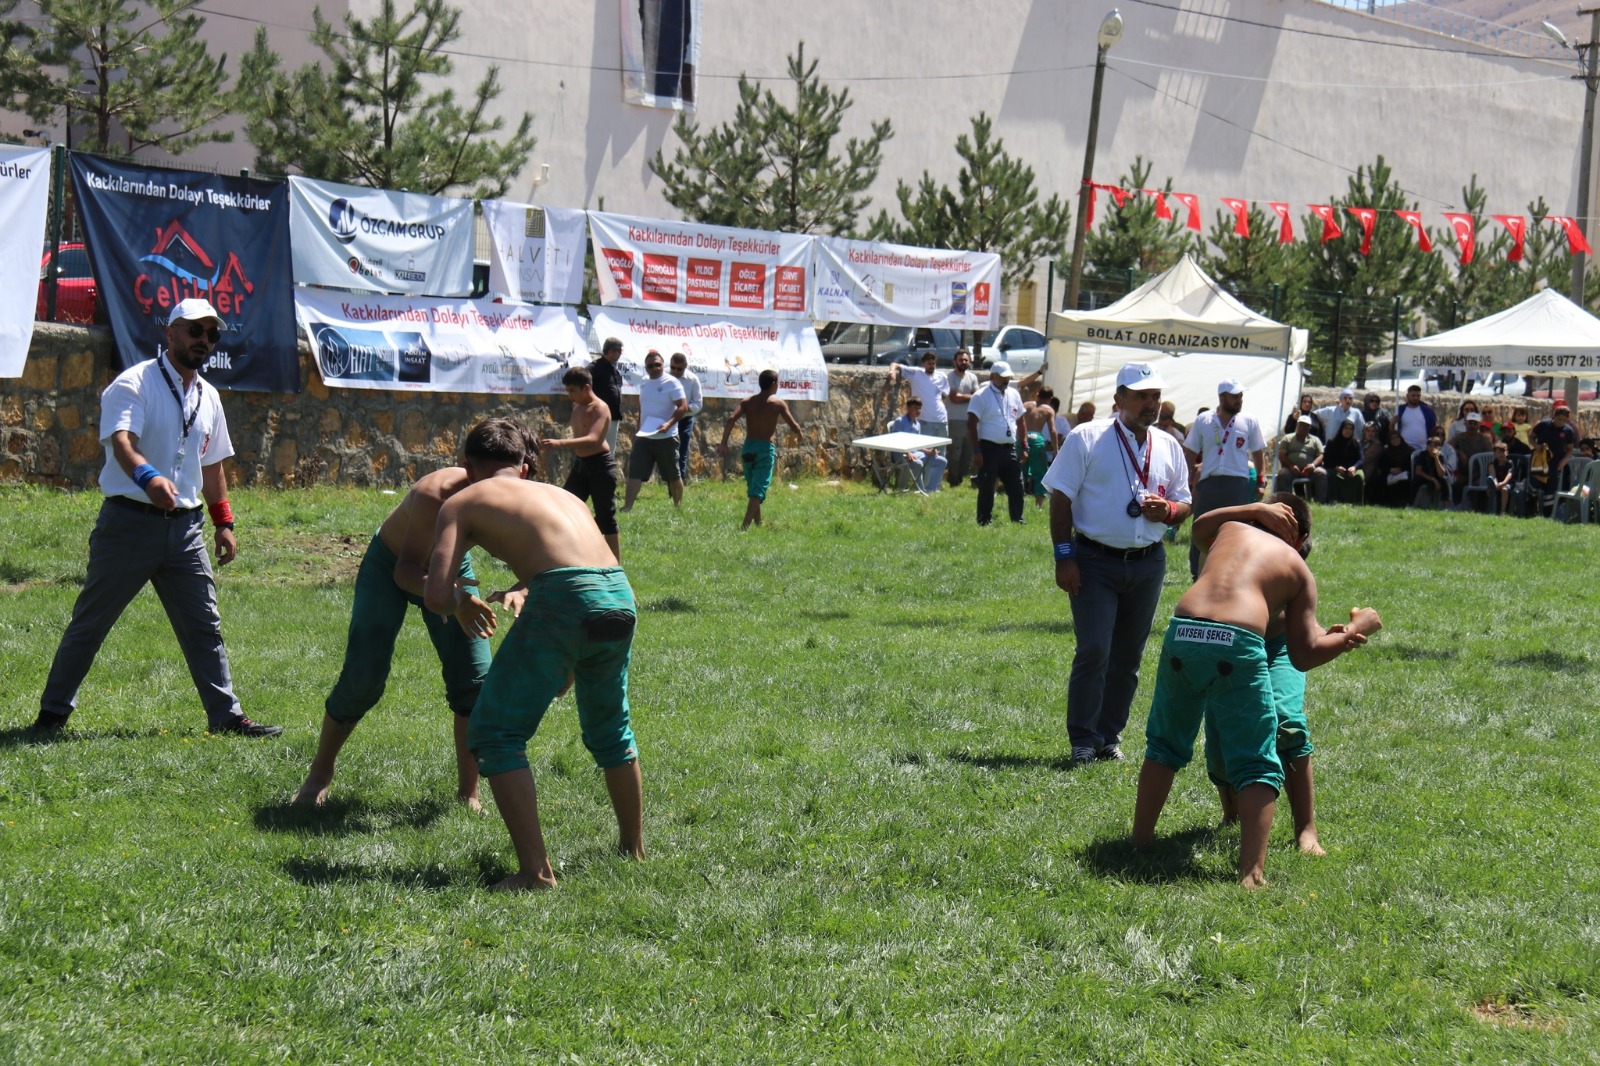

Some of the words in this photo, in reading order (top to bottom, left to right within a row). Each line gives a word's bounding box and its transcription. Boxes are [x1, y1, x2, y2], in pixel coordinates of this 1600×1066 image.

[86, 171, 166, 199] Katkılarından
[169, 184, 205, 206] Dolayı
[205, 188, 271, 211] Teşekkürler
[628, 225, 694, 247] Katkılarından
[696, 233, 726, 253] Dolayı
[728, 236, 781, 256] Teşekkürler
[848, 249, 903, 267] Katkılarından
[904, 254, 928, 272] Dolayı
[929, 257, 972, 273] Teşekkürler
[694, 265, 714, 276] YILDIZ
[687, 278, 719, 290] PASTANESİ
[733, 281, 760, 293] TİCARET
[778, 282, 800, 293] TİCARET
[341, 303, 430, 323] Katkılarından
[430, 307, 470, 329] Dolayı
[470, 310, 534, 331] Teşekkürler
[628, 318, 694, 338] Katkılarından
[694, 323, 727, 342] Dolayı
[727, 325, 780, 343] Teşekkürler
[1087, 327, 1133, 342] BOLAT
[1527, 355, 1553, 367] 0555
[1556, 355, 1576, 367] 977
[1206, 629, 1232, 643] ŞEKER
